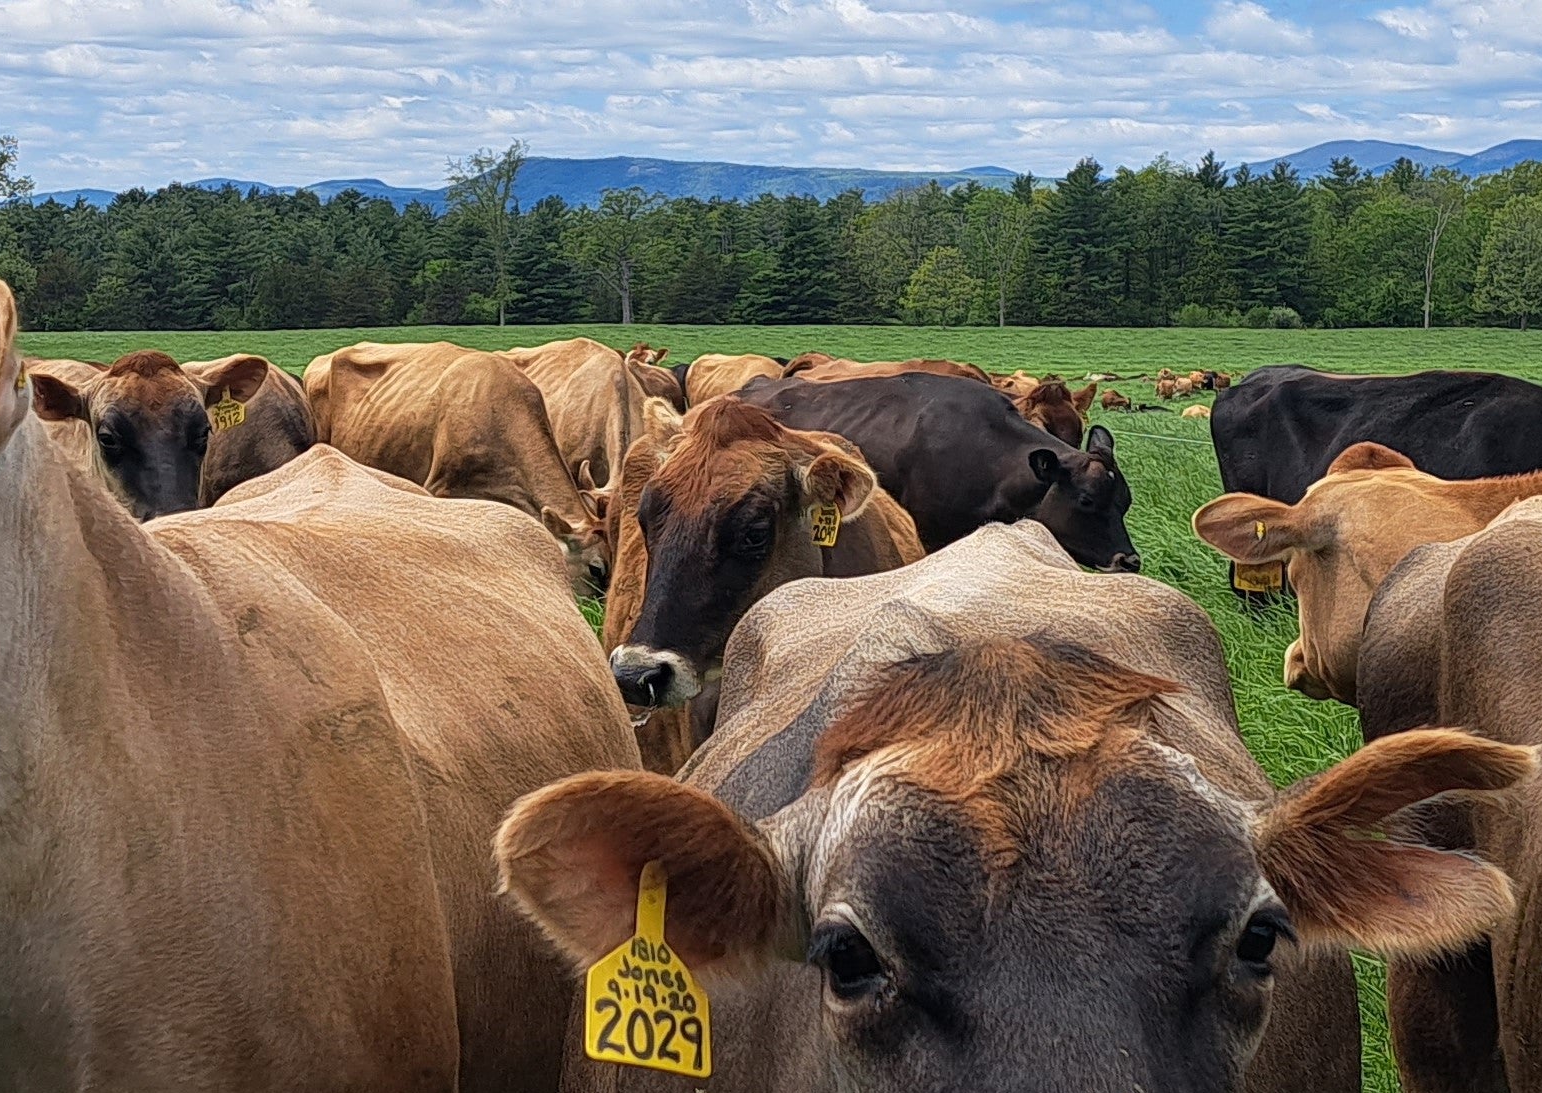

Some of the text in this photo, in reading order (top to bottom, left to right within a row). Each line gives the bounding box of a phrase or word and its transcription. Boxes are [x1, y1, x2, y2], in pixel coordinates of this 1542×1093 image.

[618, 955, 687, 992] Jones
[607, 978, 696, 1014] 9.19.20
[595, 997, 703, 1071] 2029
